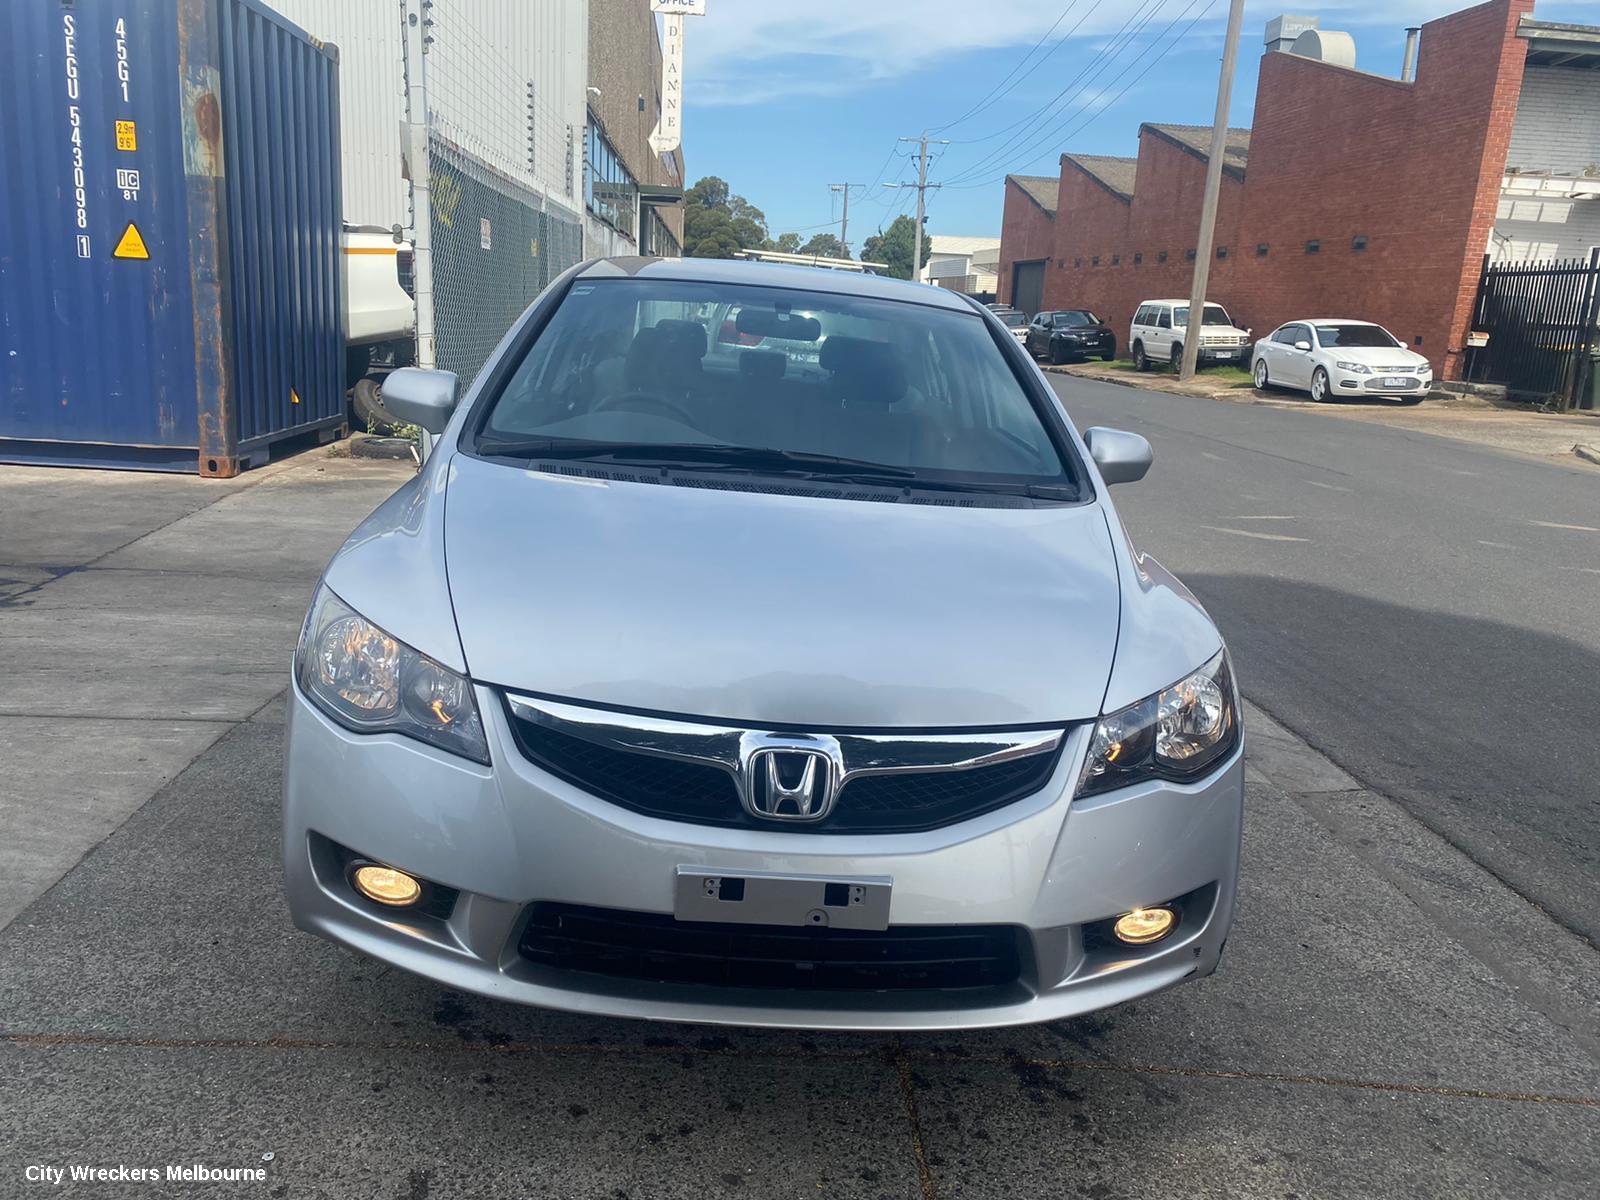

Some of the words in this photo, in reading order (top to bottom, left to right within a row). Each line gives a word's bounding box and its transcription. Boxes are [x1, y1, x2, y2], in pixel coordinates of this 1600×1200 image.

[63, 15, 79, 99] SEGU
[115, 18, 129, 102] 45G1
[667, 26, 678, 127] DIANNE
[69, 106, 87, 228] 543098
[123, 190, 137, 200] 81
[79, 236, 88, 257] 1
